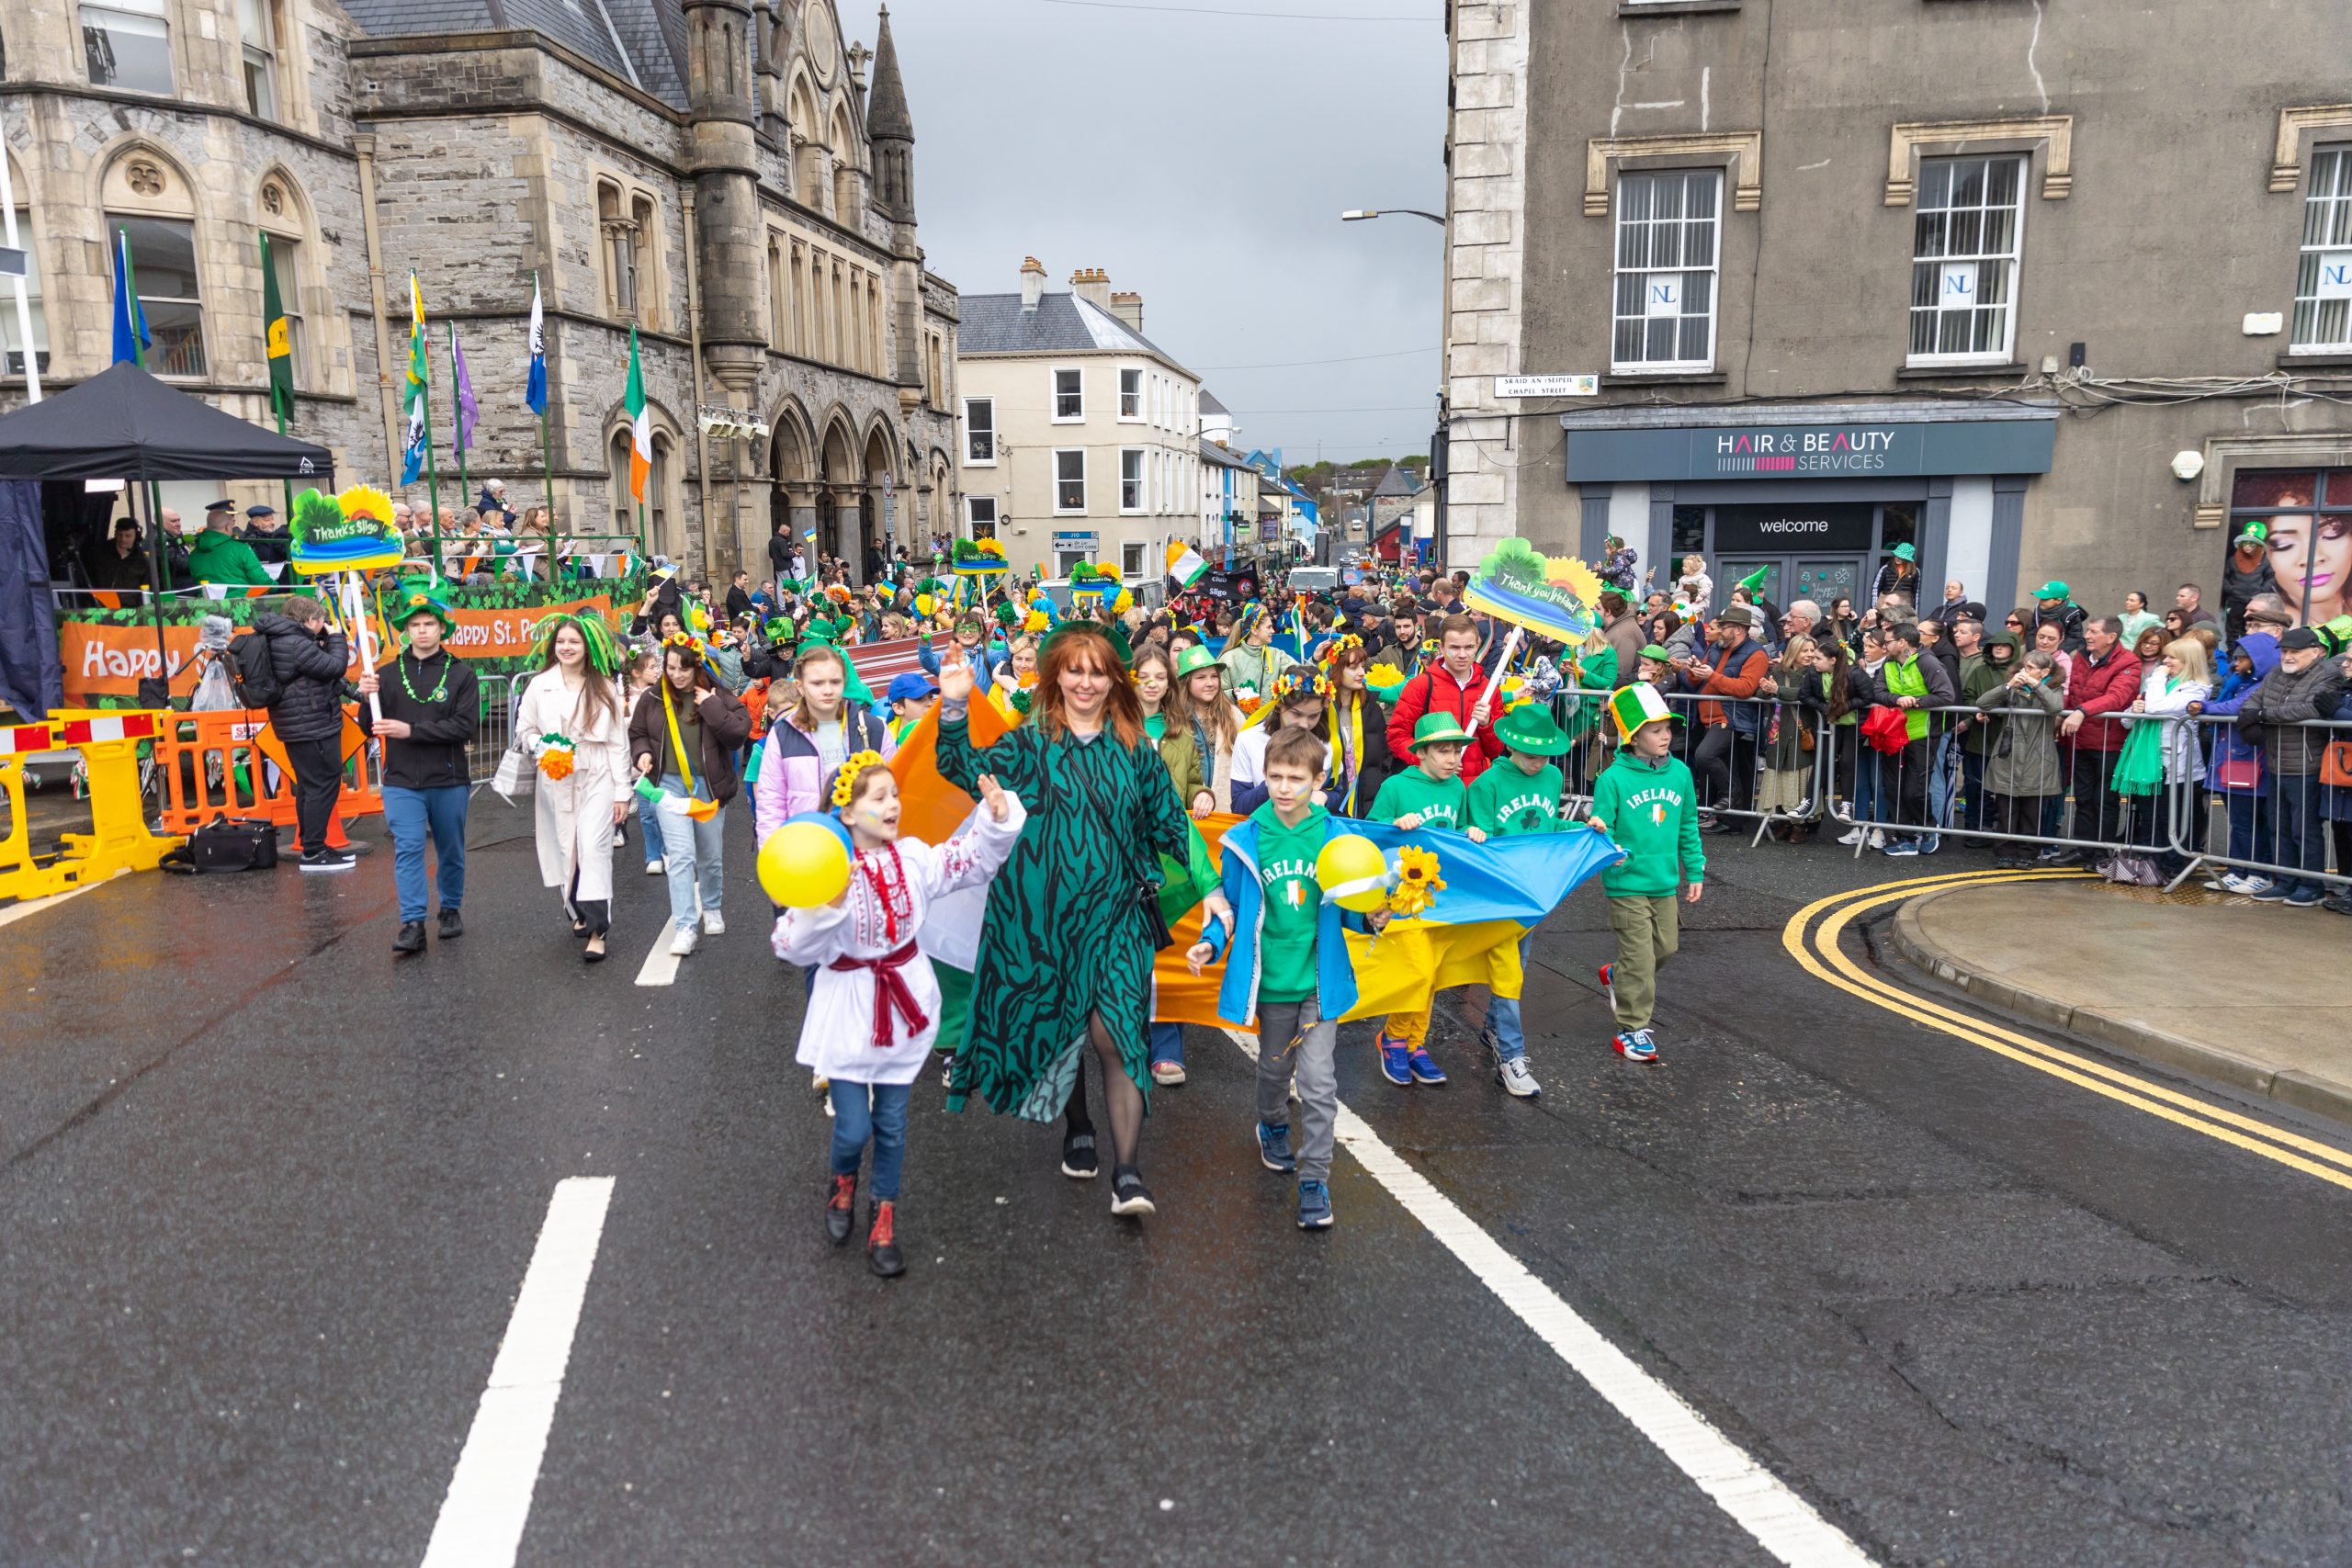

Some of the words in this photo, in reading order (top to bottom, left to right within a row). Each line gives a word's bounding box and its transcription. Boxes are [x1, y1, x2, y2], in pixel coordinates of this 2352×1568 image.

[1945, 276, 1972, 294] NL
[2324, 265, 2352, 285] NL
[1651, 285, 1676, 304] NL
[1717, 434, 1774, 454] HAIR
[1780, 434, 1798, 453] &
[1804, 432, 1895, 452] BEAUTY
[1797, 454, 1884, 470] SERVICES
[1759, 519, 1828, 533] welcome
[1209, 587, 1227, 597] Sligo
[493, 619, 517, 645] St.
[83, 640, 180, 679] Happy
[1626, 787, 1682, 809] IRELAND
[1497, 794, 1555, 823] IRELAND
